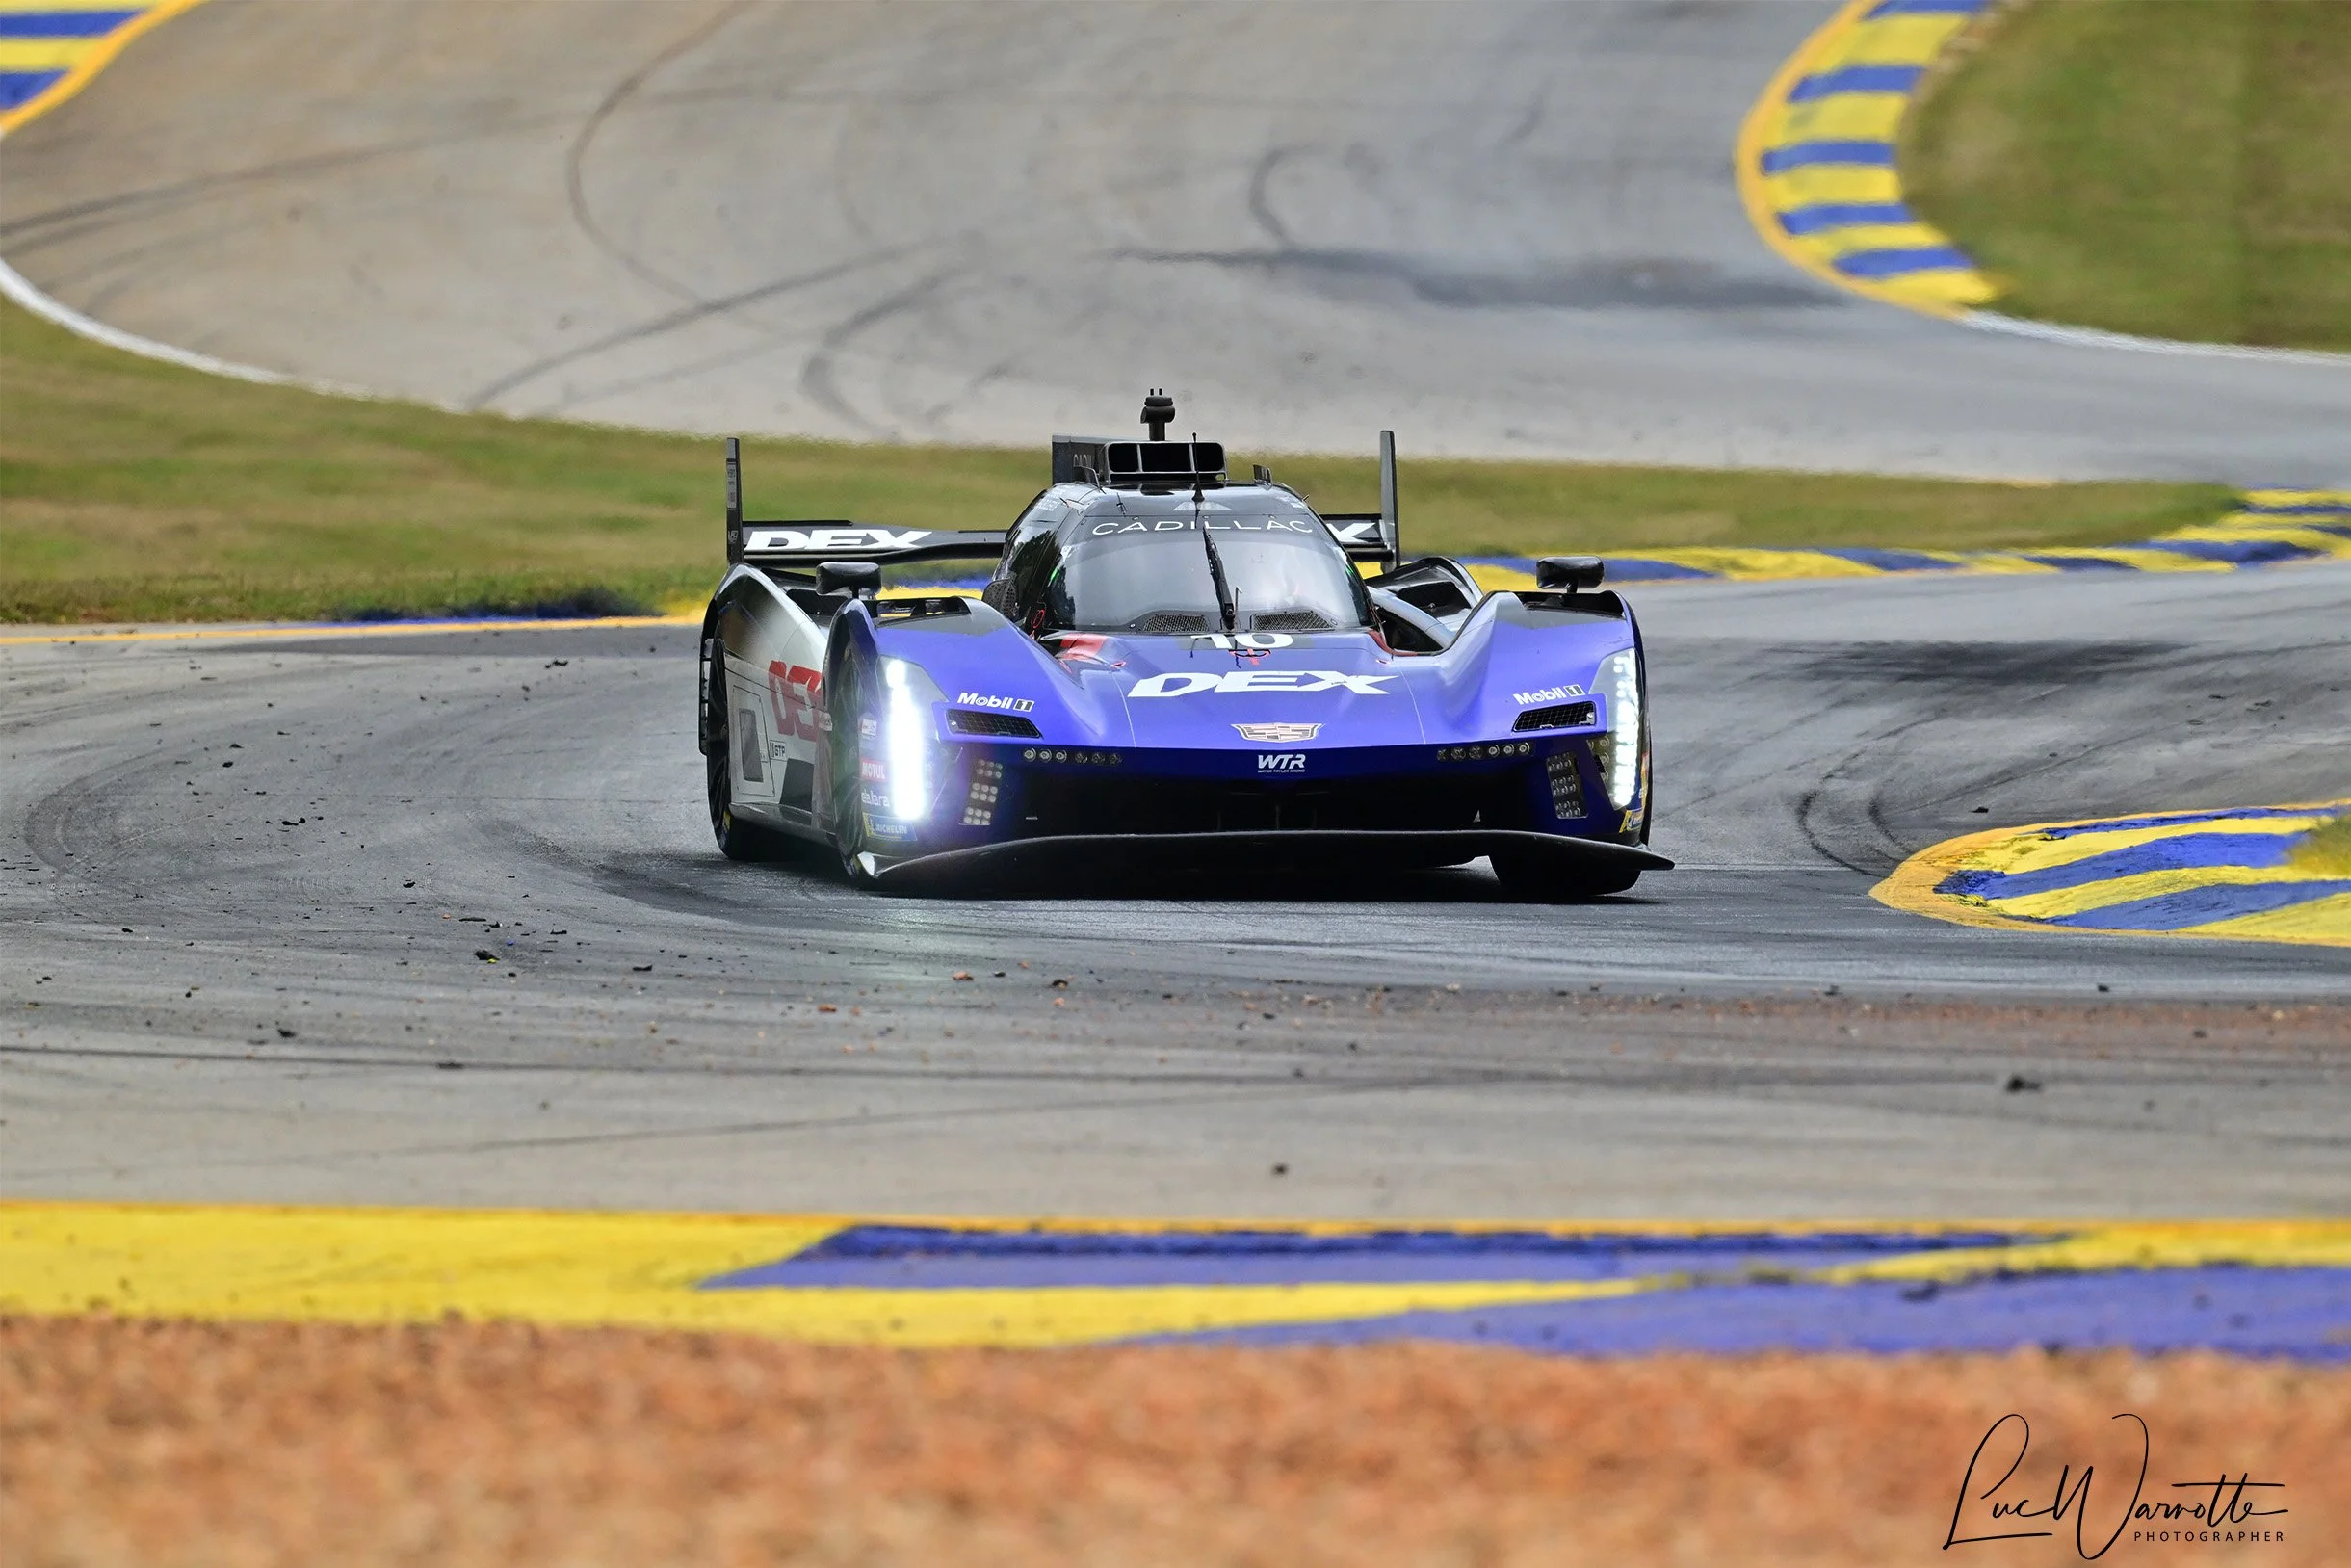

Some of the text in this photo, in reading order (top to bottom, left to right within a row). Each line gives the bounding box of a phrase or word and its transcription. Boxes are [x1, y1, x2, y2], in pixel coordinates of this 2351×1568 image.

[1092, 519, 1313, 536] CADILLAC
[744, 530, 933, 551] DEX
[1190, 633, 1293, 649] 10
[1127, 670, 1399, 697] DEX
[956, 692, 1013, 710] Mobil
[1513, 687, 1567, 705] Mobil
[862, 761, 886, 780] MOTUL
[1258, 754, 1306, 769] WTR
